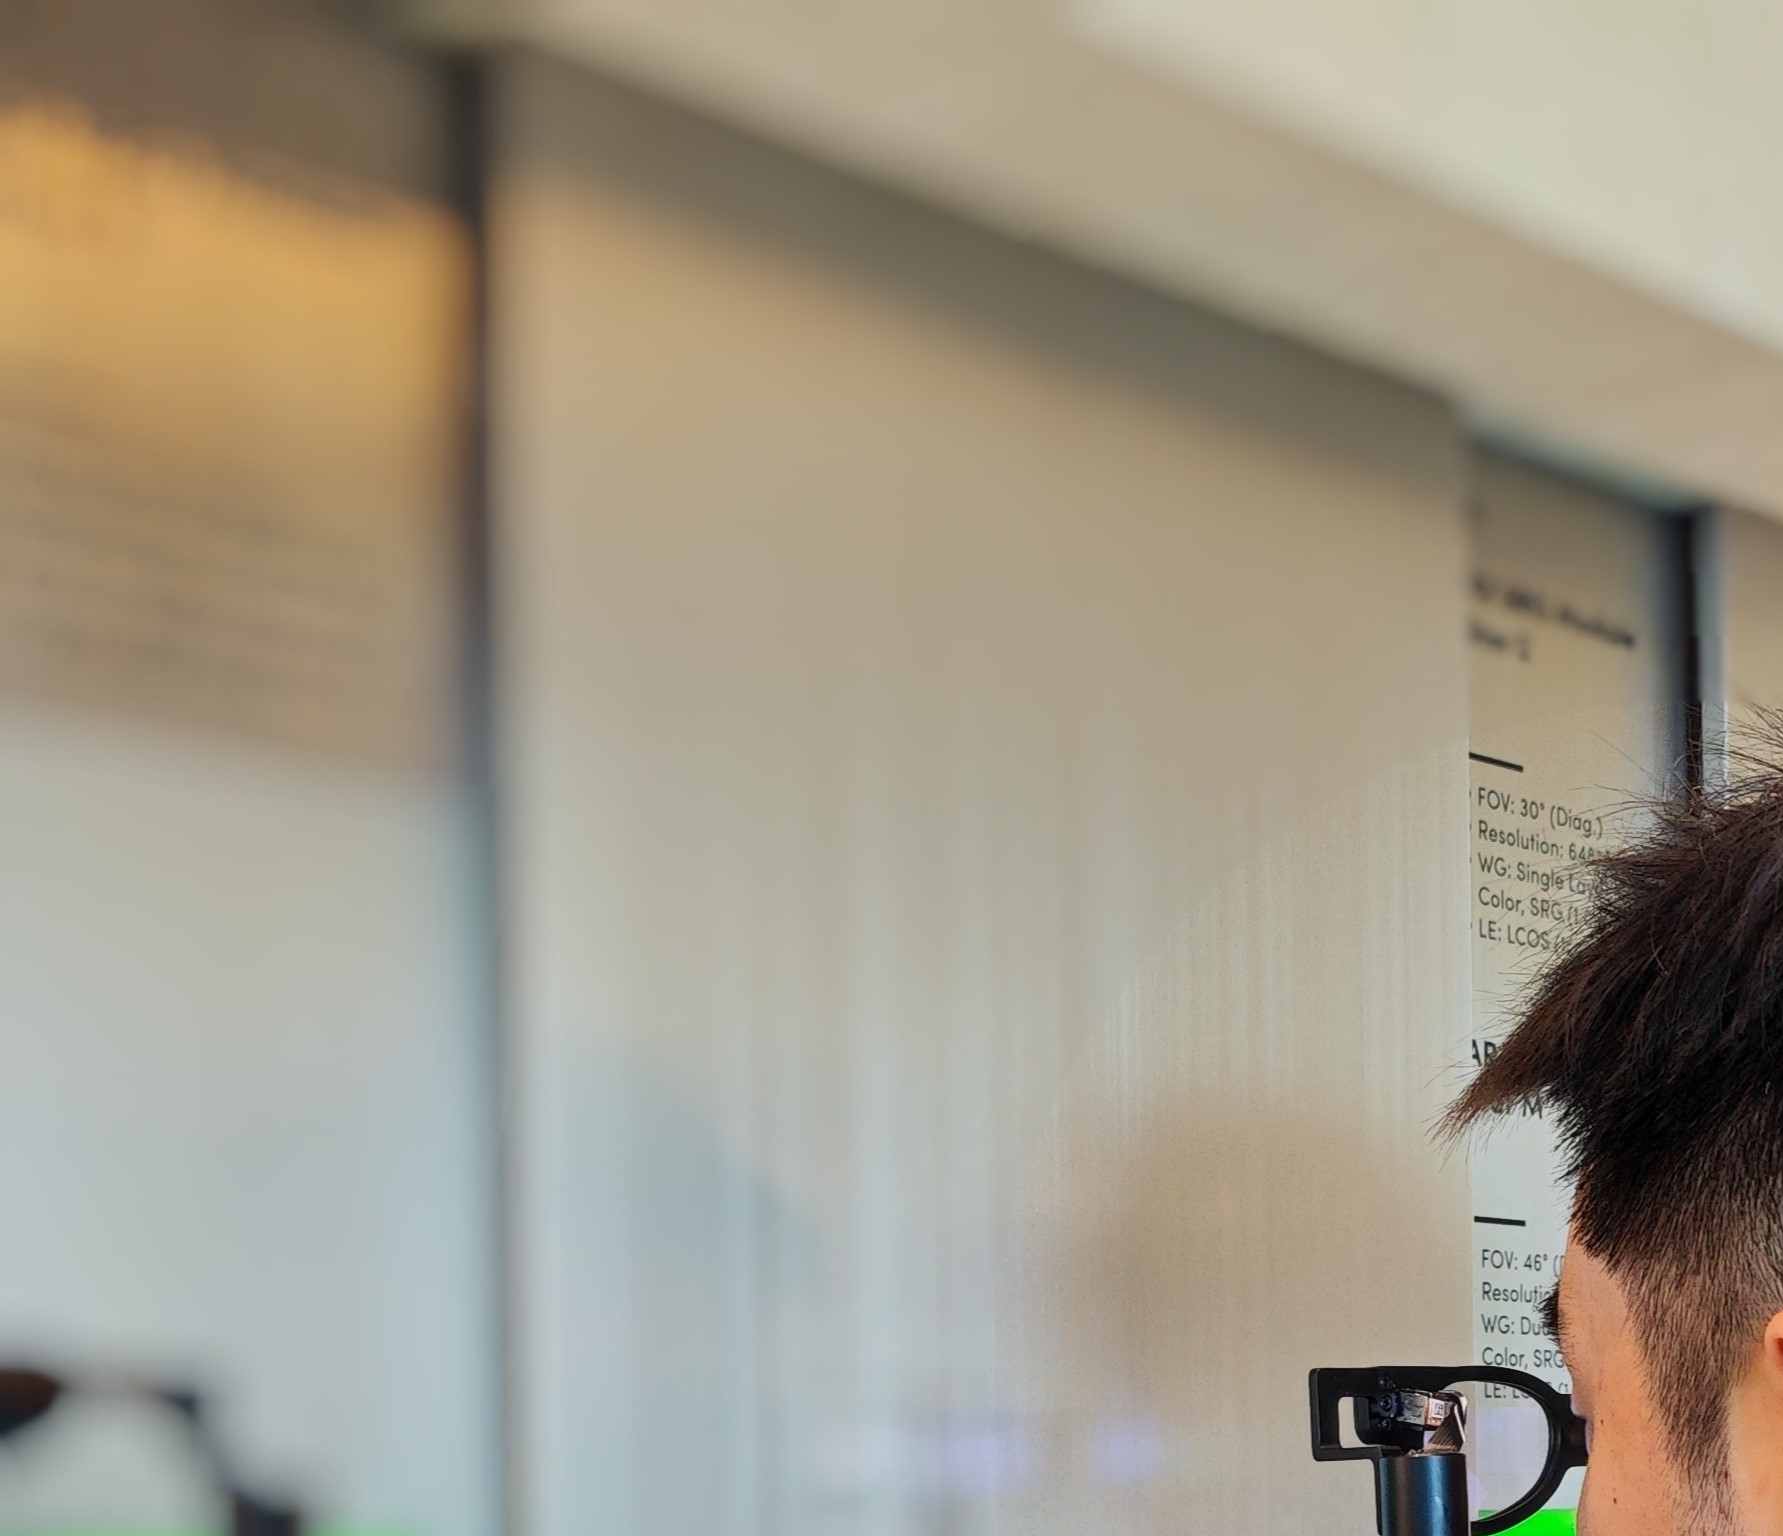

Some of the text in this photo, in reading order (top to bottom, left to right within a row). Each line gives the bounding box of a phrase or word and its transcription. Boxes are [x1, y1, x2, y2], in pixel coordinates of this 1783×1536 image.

[1478, 786, 1604, 841] FOV: 30° (Diag.)
[1478, 819, 1564, 859] Resolution:
[1477, 852, 1512, 880] WG:
[1516, 861, 1565, 893] Single
[1478, 886, 1526, 917] Color,
[1530, 897, 1564, 922] SRG
[1478, 918, 1503, 943] LE:
[1507, 924, 1551, 951] LCOS
[1481, 1248, 1519, 1271] FOV:
[1523, 1253, 1549, 1273] 46°
[1480, 1312, 1516, 1336] WG:
[1481, 1346, 1529, 1371] Color,
